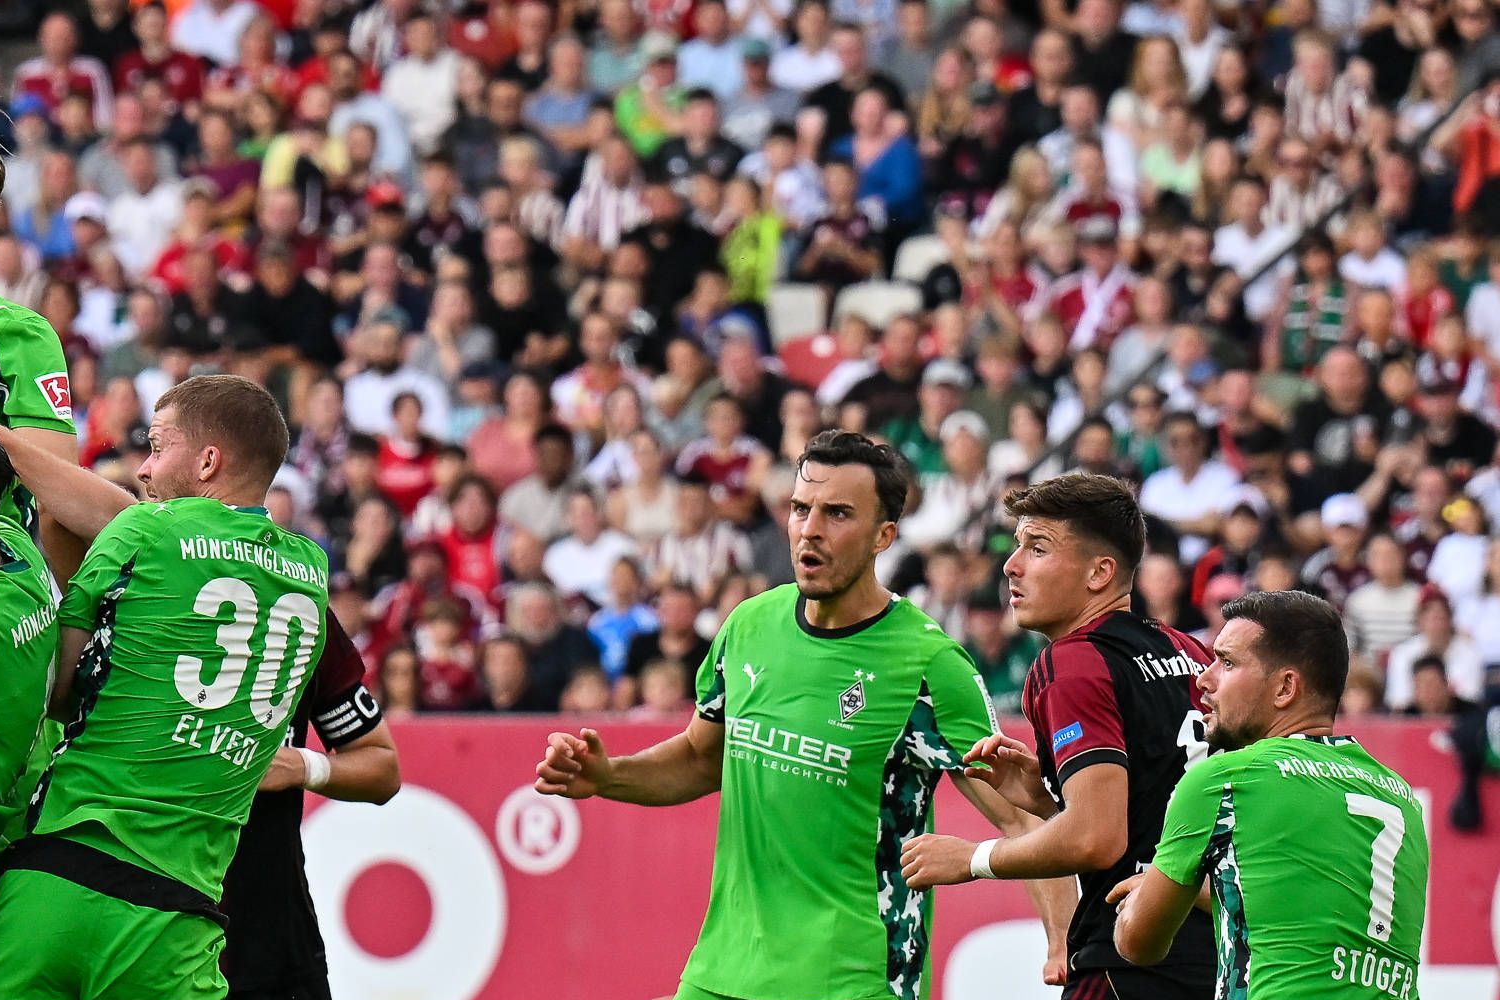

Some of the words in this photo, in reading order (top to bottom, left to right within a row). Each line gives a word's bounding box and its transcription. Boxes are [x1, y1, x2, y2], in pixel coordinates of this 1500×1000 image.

[174, 577, 320, 729] 30
[354, 685, 379, 719] C
[762, 760, 848, 787] LEUCHTEN
[1345, 793, 1405, 942] 7
